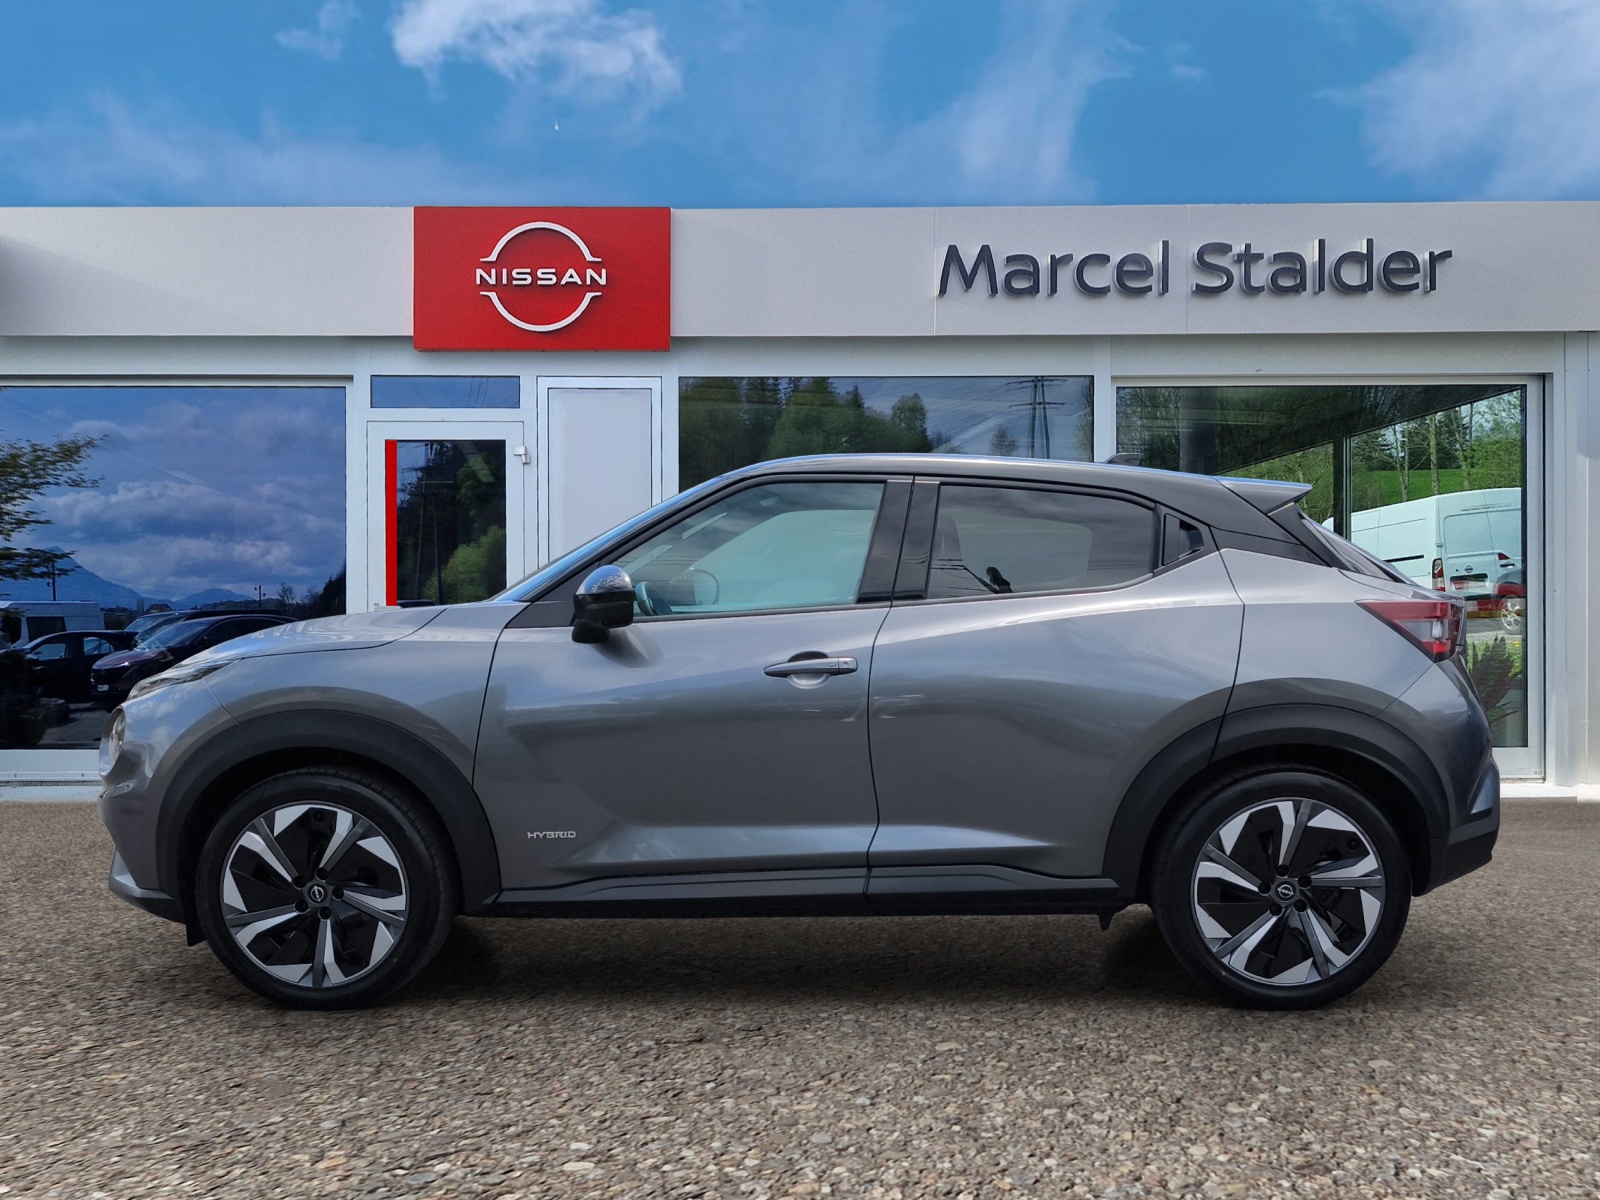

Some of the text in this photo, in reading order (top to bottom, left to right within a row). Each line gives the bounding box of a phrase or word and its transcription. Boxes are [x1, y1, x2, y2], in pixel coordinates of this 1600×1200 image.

[938, 238, 1453, 297] Marcel Stalder
[475, 268, 607, 286] NISSAN
[526, 830, 577, 840] HYBRID
